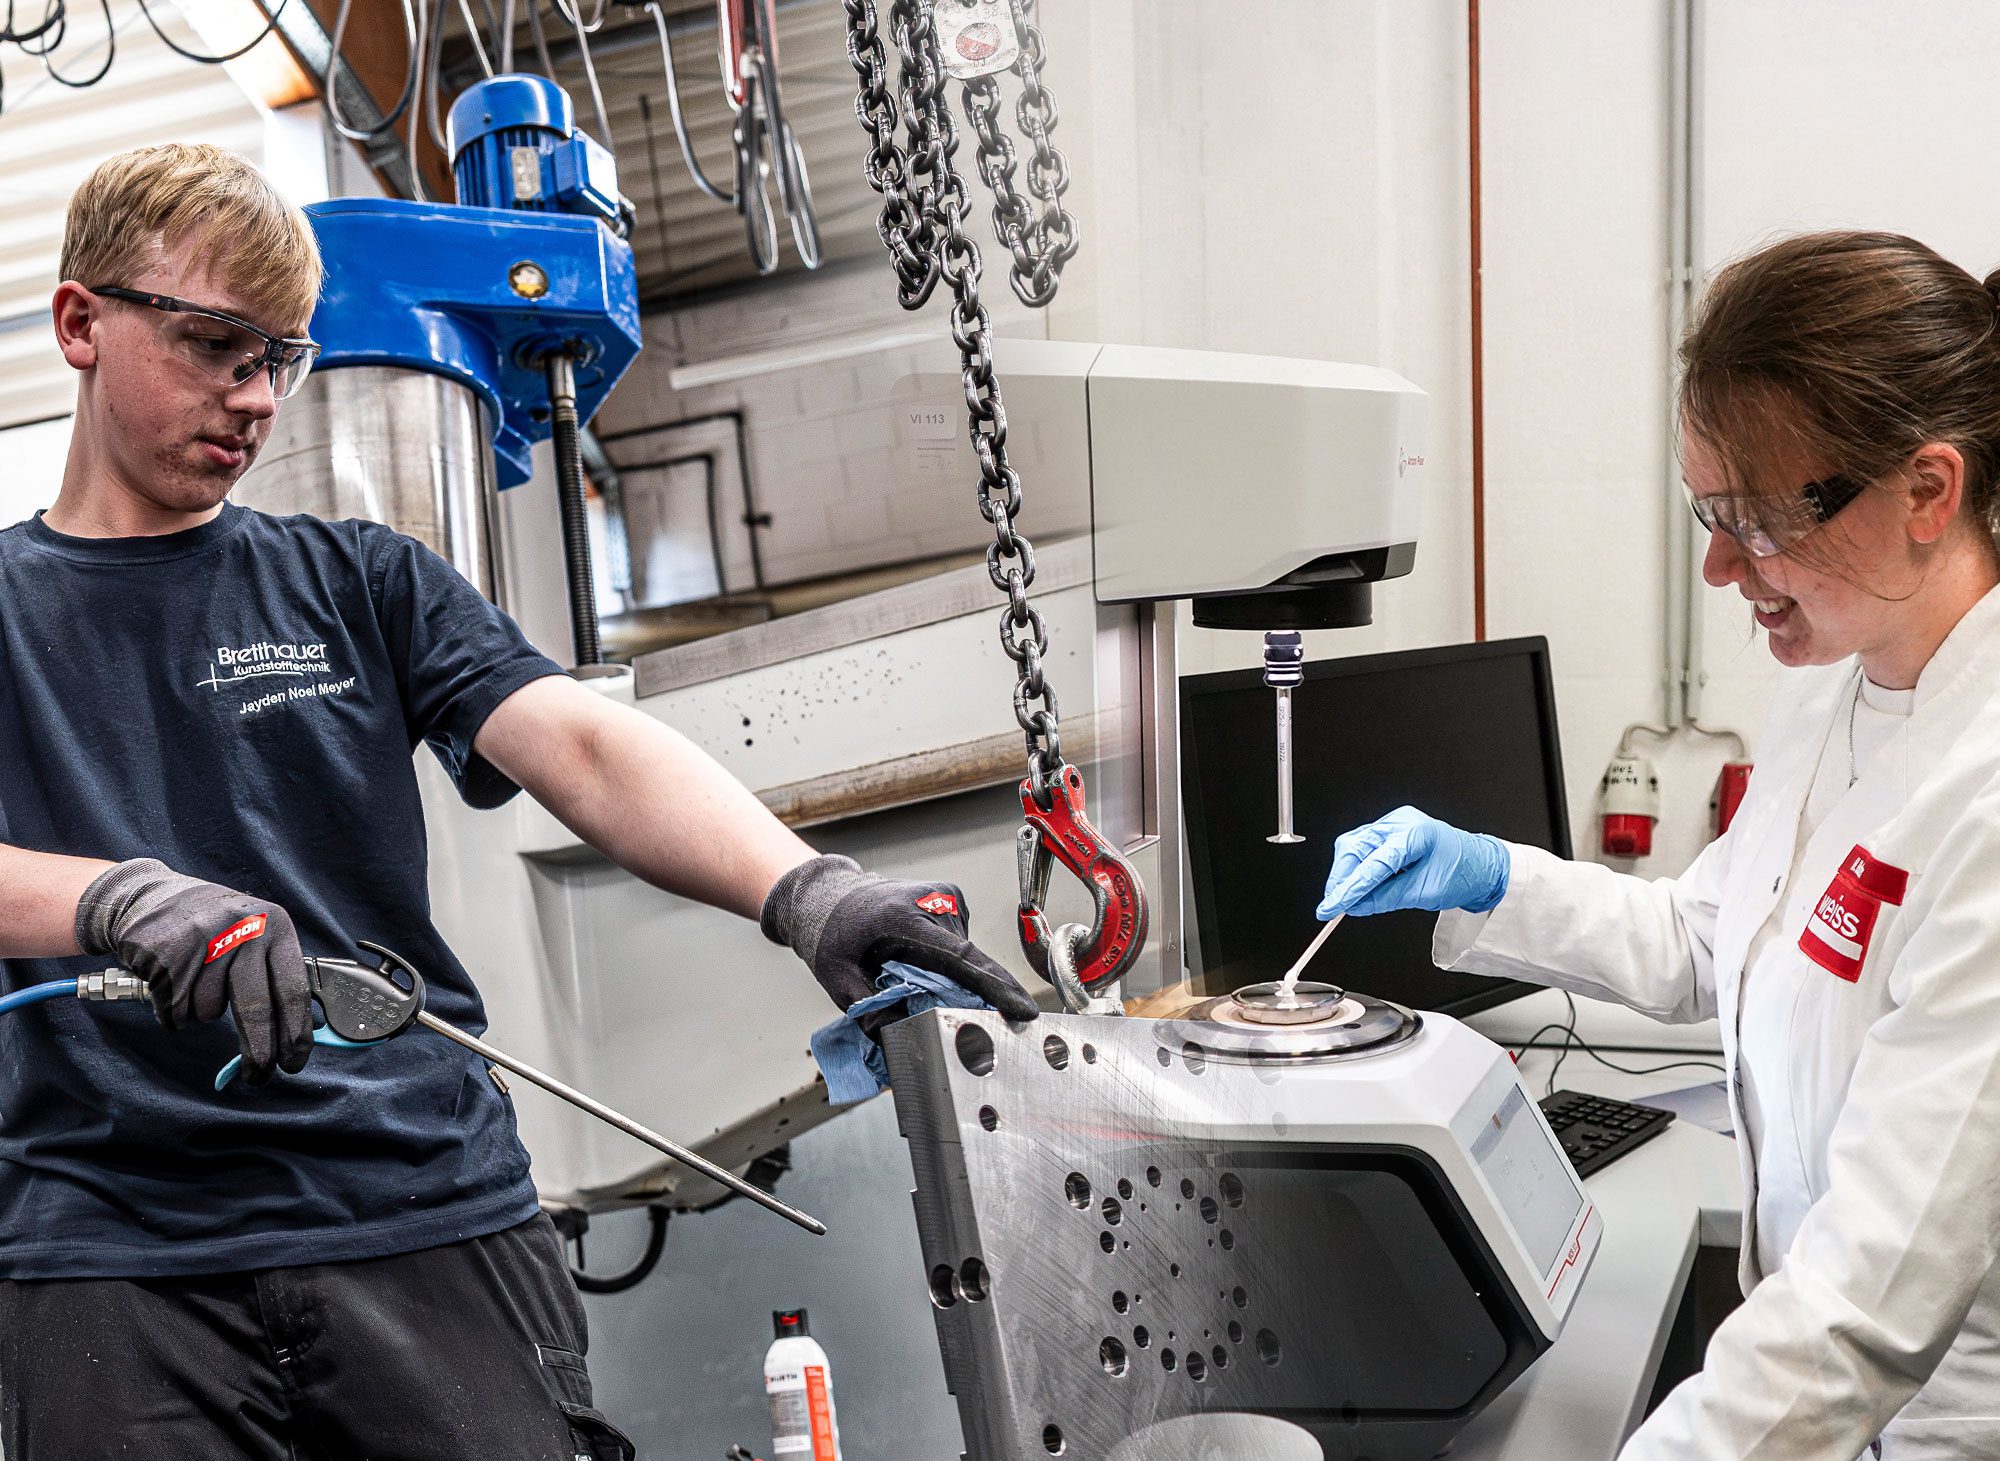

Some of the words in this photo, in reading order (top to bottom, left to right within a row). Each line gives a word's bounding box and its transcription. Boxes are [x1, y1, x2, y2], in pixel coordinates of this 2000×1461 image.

[910, 414, 922, 424] VI
[925, 413, 945, 424] 113
[217, 641, 327, 665] Bretthauer
[233, 661, 331, 677] Kunststofftechnik
[239, 691, 286, 714] Jayden
[288, 684, 316, 700] Noel
[318, 676, 356, 695] Meyer
[1817, 894, 1860, 938] weiss
[211, 920, 261, 958] HOLEX
